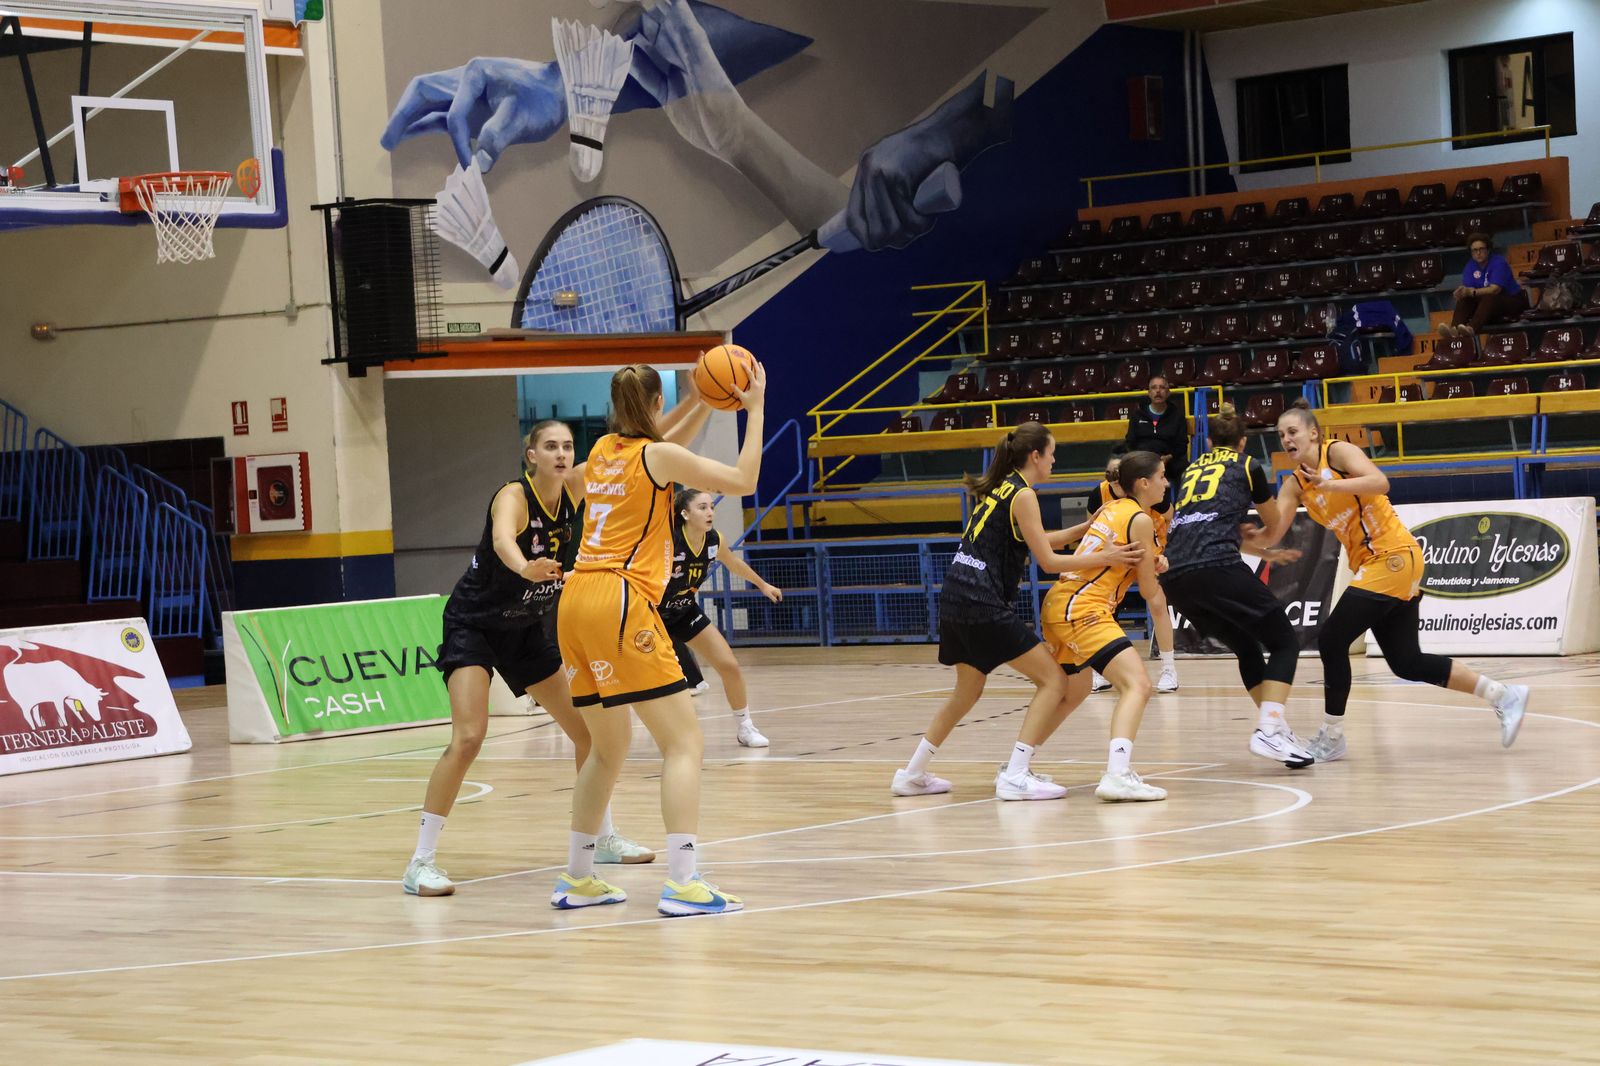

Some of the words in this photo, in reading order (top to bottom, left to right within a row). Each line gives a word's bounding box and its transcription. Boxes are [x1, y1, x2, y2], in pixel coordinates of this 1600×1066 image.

[1422, 260, 1432, 268] 62
[1175, 464, 1225, 510] 33
[587, 503, 613, 546] 7
[1489, 534, 1560, 573] Iglesias
[1426, 577, 1471, 586] Embutidos
[1472, 578, 1478, 587] y
[1480, 576, 1520, 585] Jamones
[289, 644, 444, 686] CUEVA
[305, 691, 385, 718] CASH
[0, 727, 81, 751] TERNERA
[91, 719, 148, 740] ALISTE
